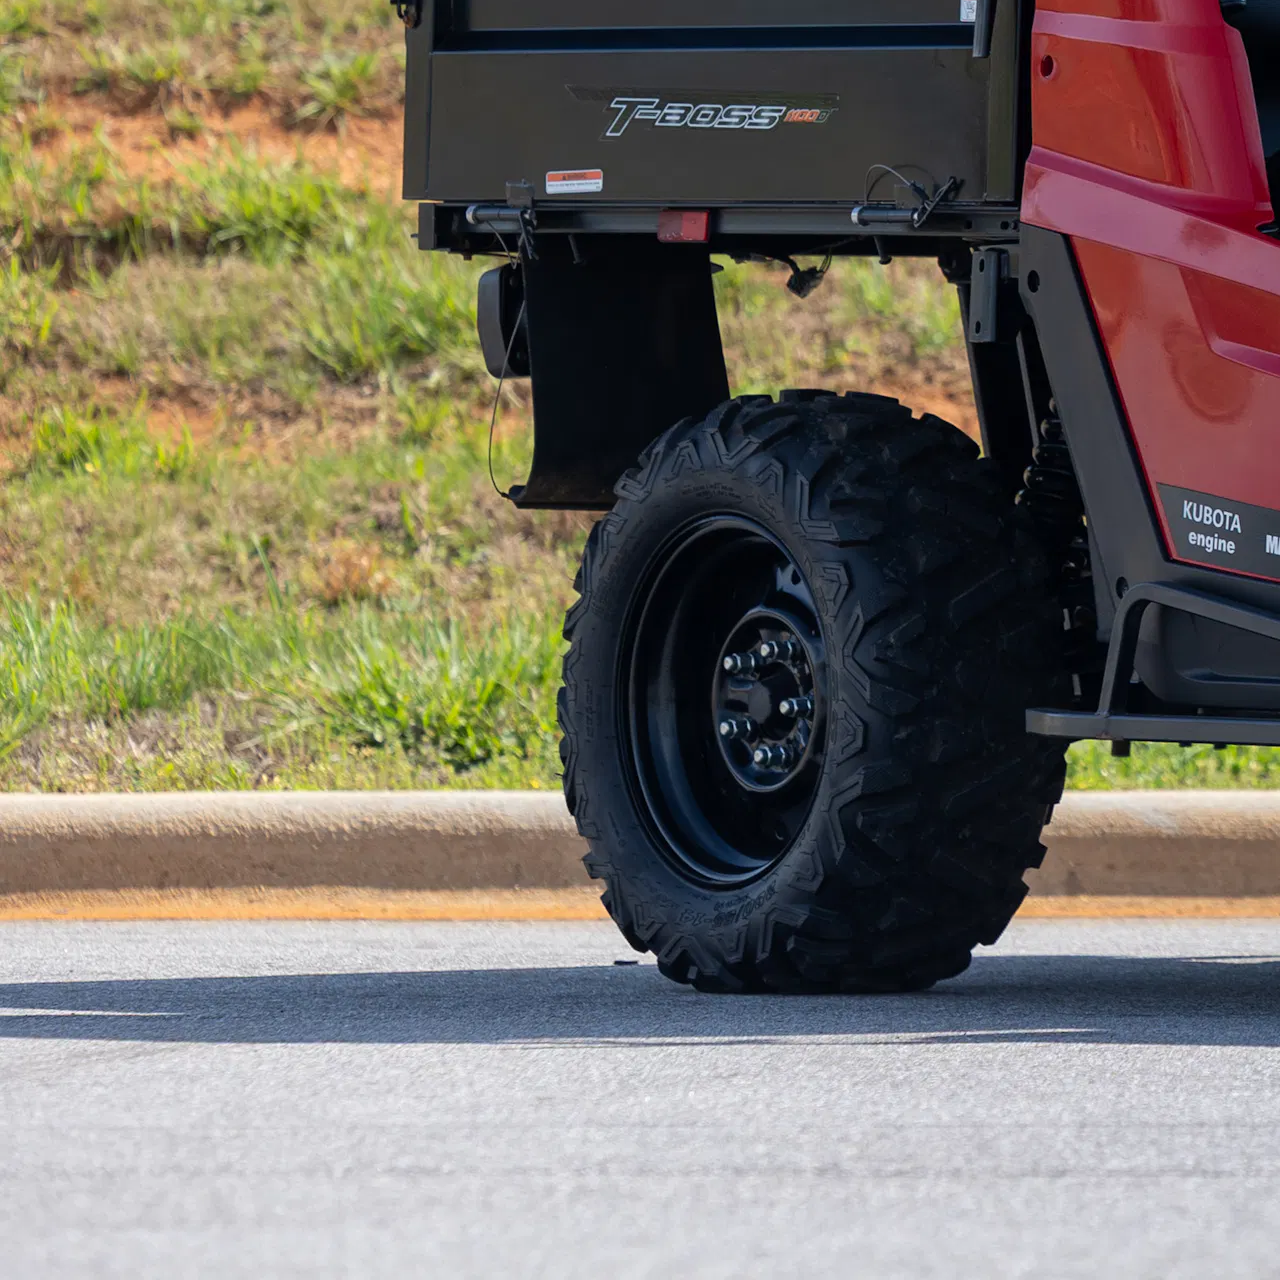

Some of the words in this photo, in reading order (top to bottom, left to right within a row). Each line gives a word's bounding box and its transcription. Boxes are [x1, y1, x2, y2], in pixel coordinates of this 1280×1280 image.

[605, 97, 787, 137] T-BOSS
[1182, 499, 1242, 534] KUBOTA
[1188, 531, 1236, 554] engine
